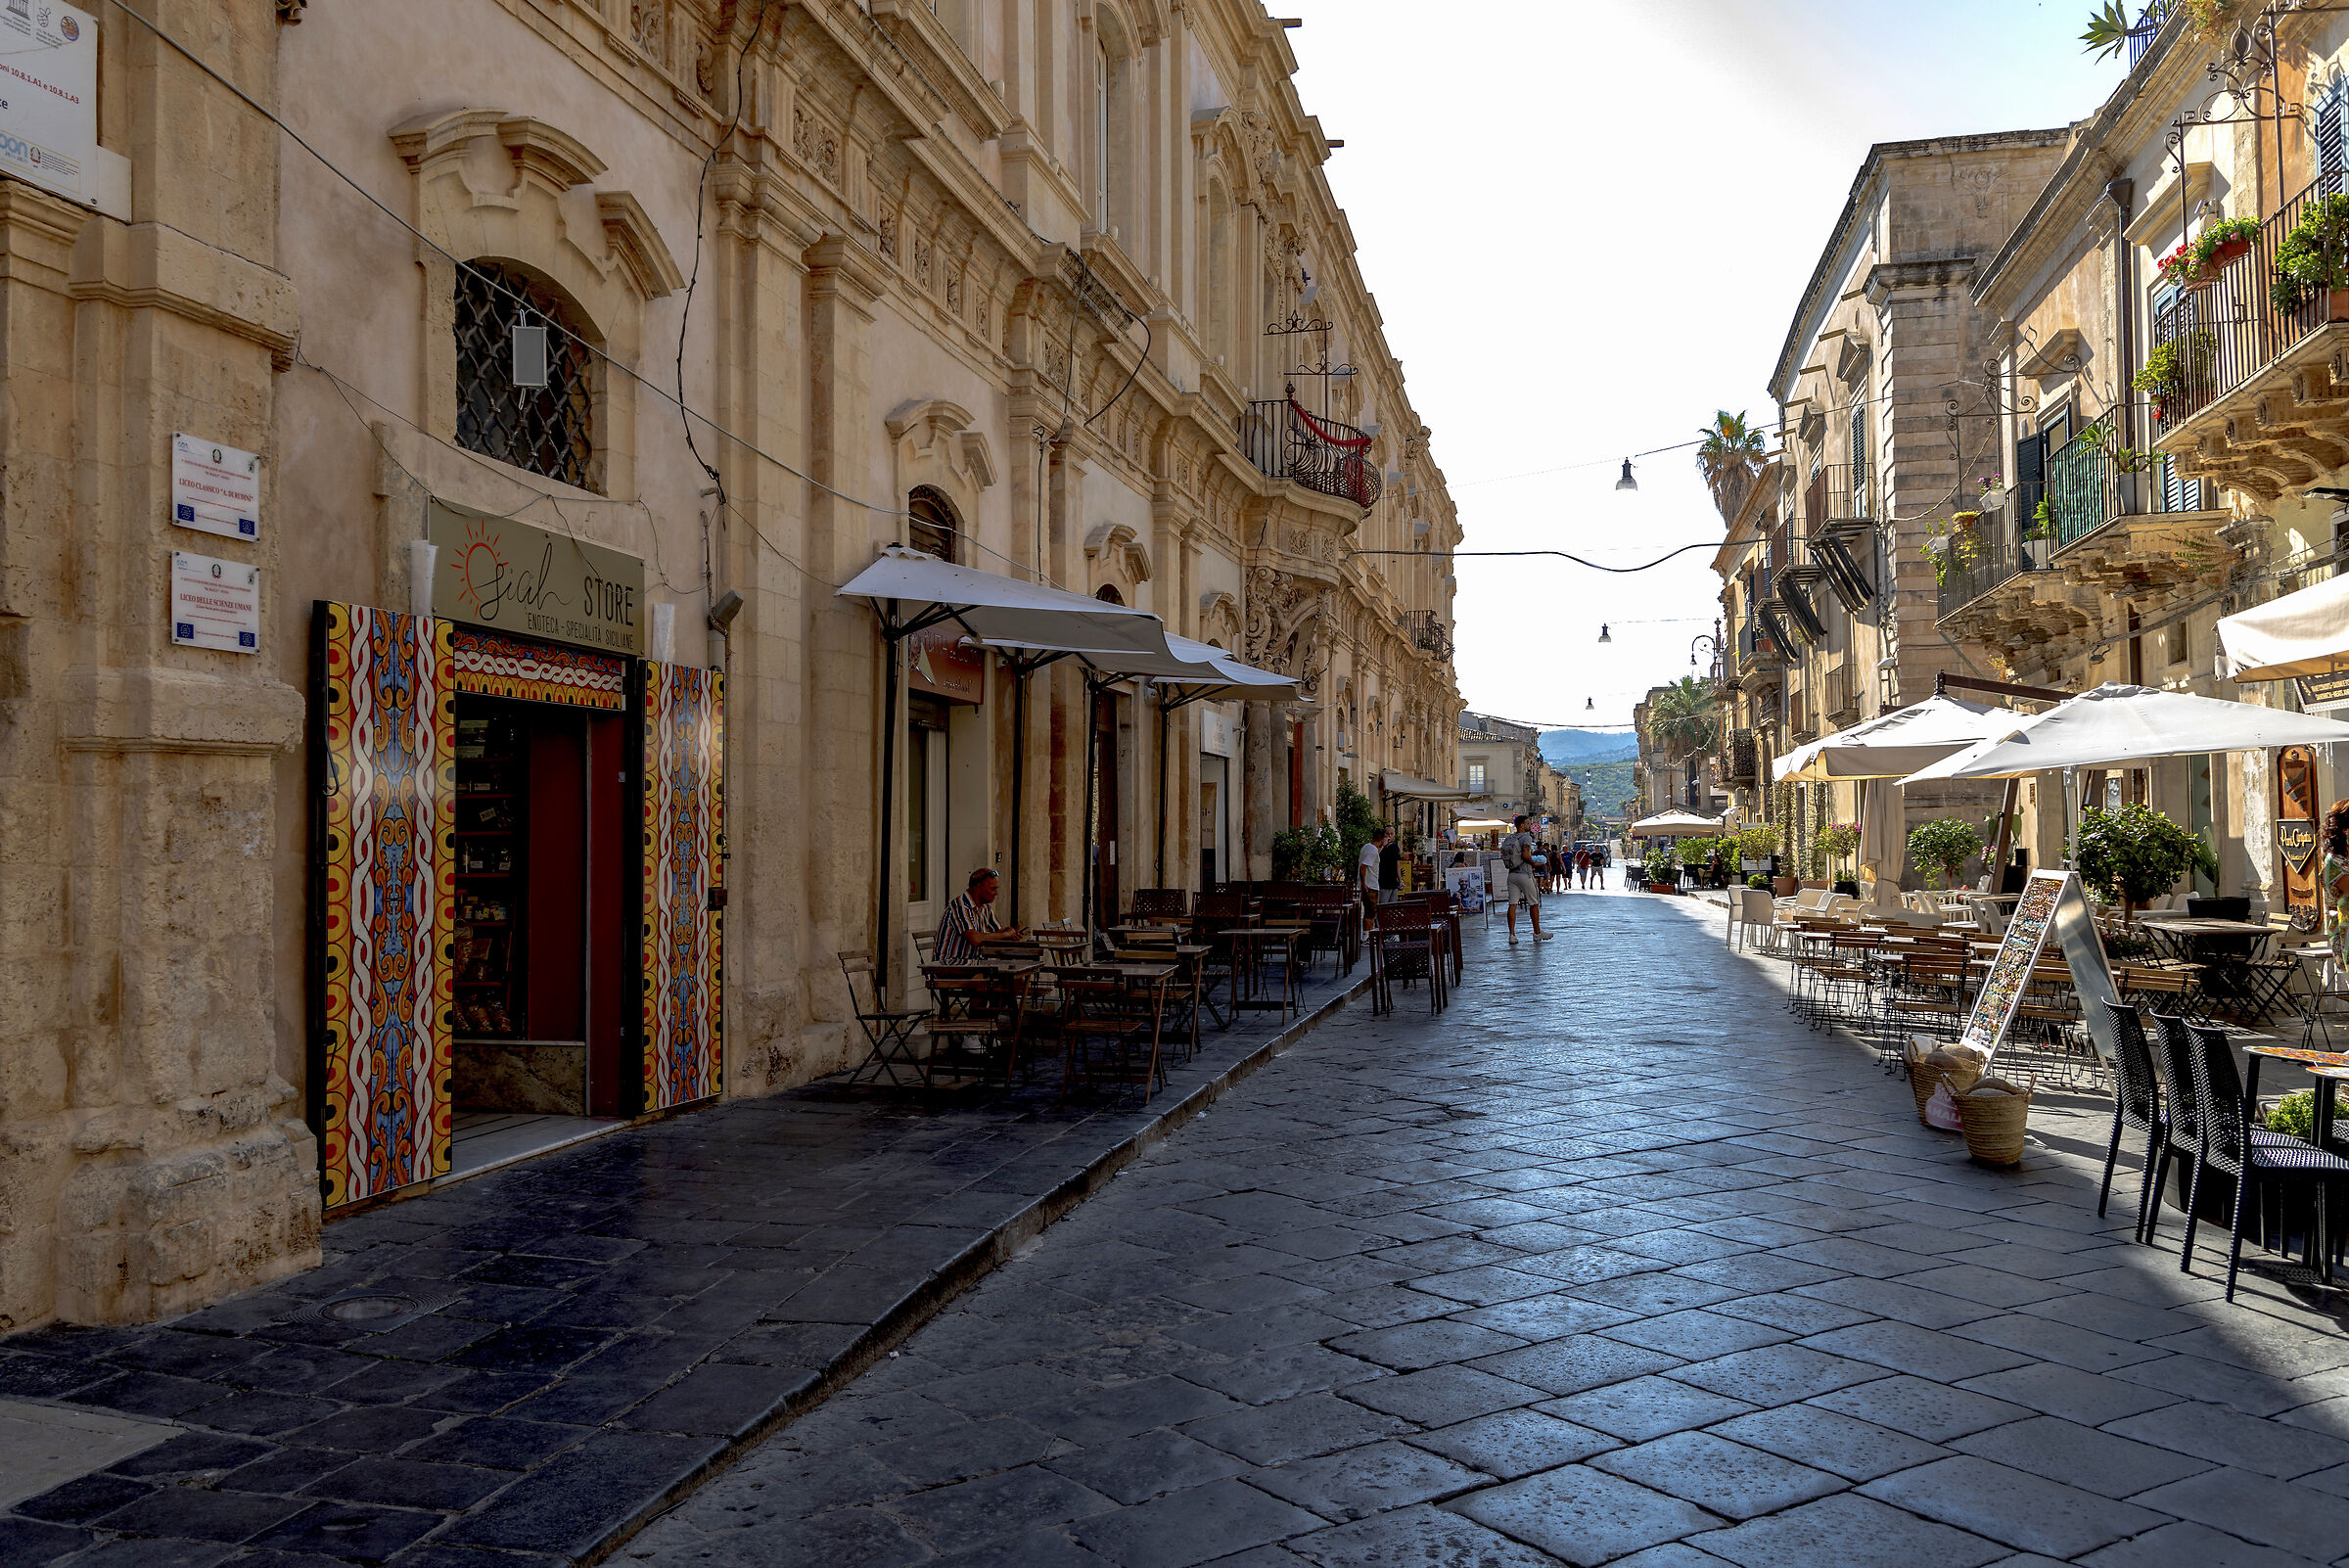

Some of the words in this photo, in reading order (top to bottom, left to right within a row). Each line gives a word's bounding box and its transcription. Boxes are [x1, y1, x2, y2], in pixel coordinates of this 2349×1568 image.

[11, 68, 42, 87] 10.8.1.A1
[49, 85, 79, 105] 10.8.1.A3
[179, 478, 196, 488] LICEO
[195, 483, 220, 494] CLASSICO
[179, 593, 196, 603] LICEO
[196, 596, 213, 605] DELLE
[212, 599, 234, 609] SCIENZE
[234, 601, 253, 612] UMANE
[583, 575, 634, 627] STORE
[528, 612, 560, 634] ENOTECA
[566, 619, 602, 643] SPECIALITÀ
[605, 629, 634, 651] SICILIANE
